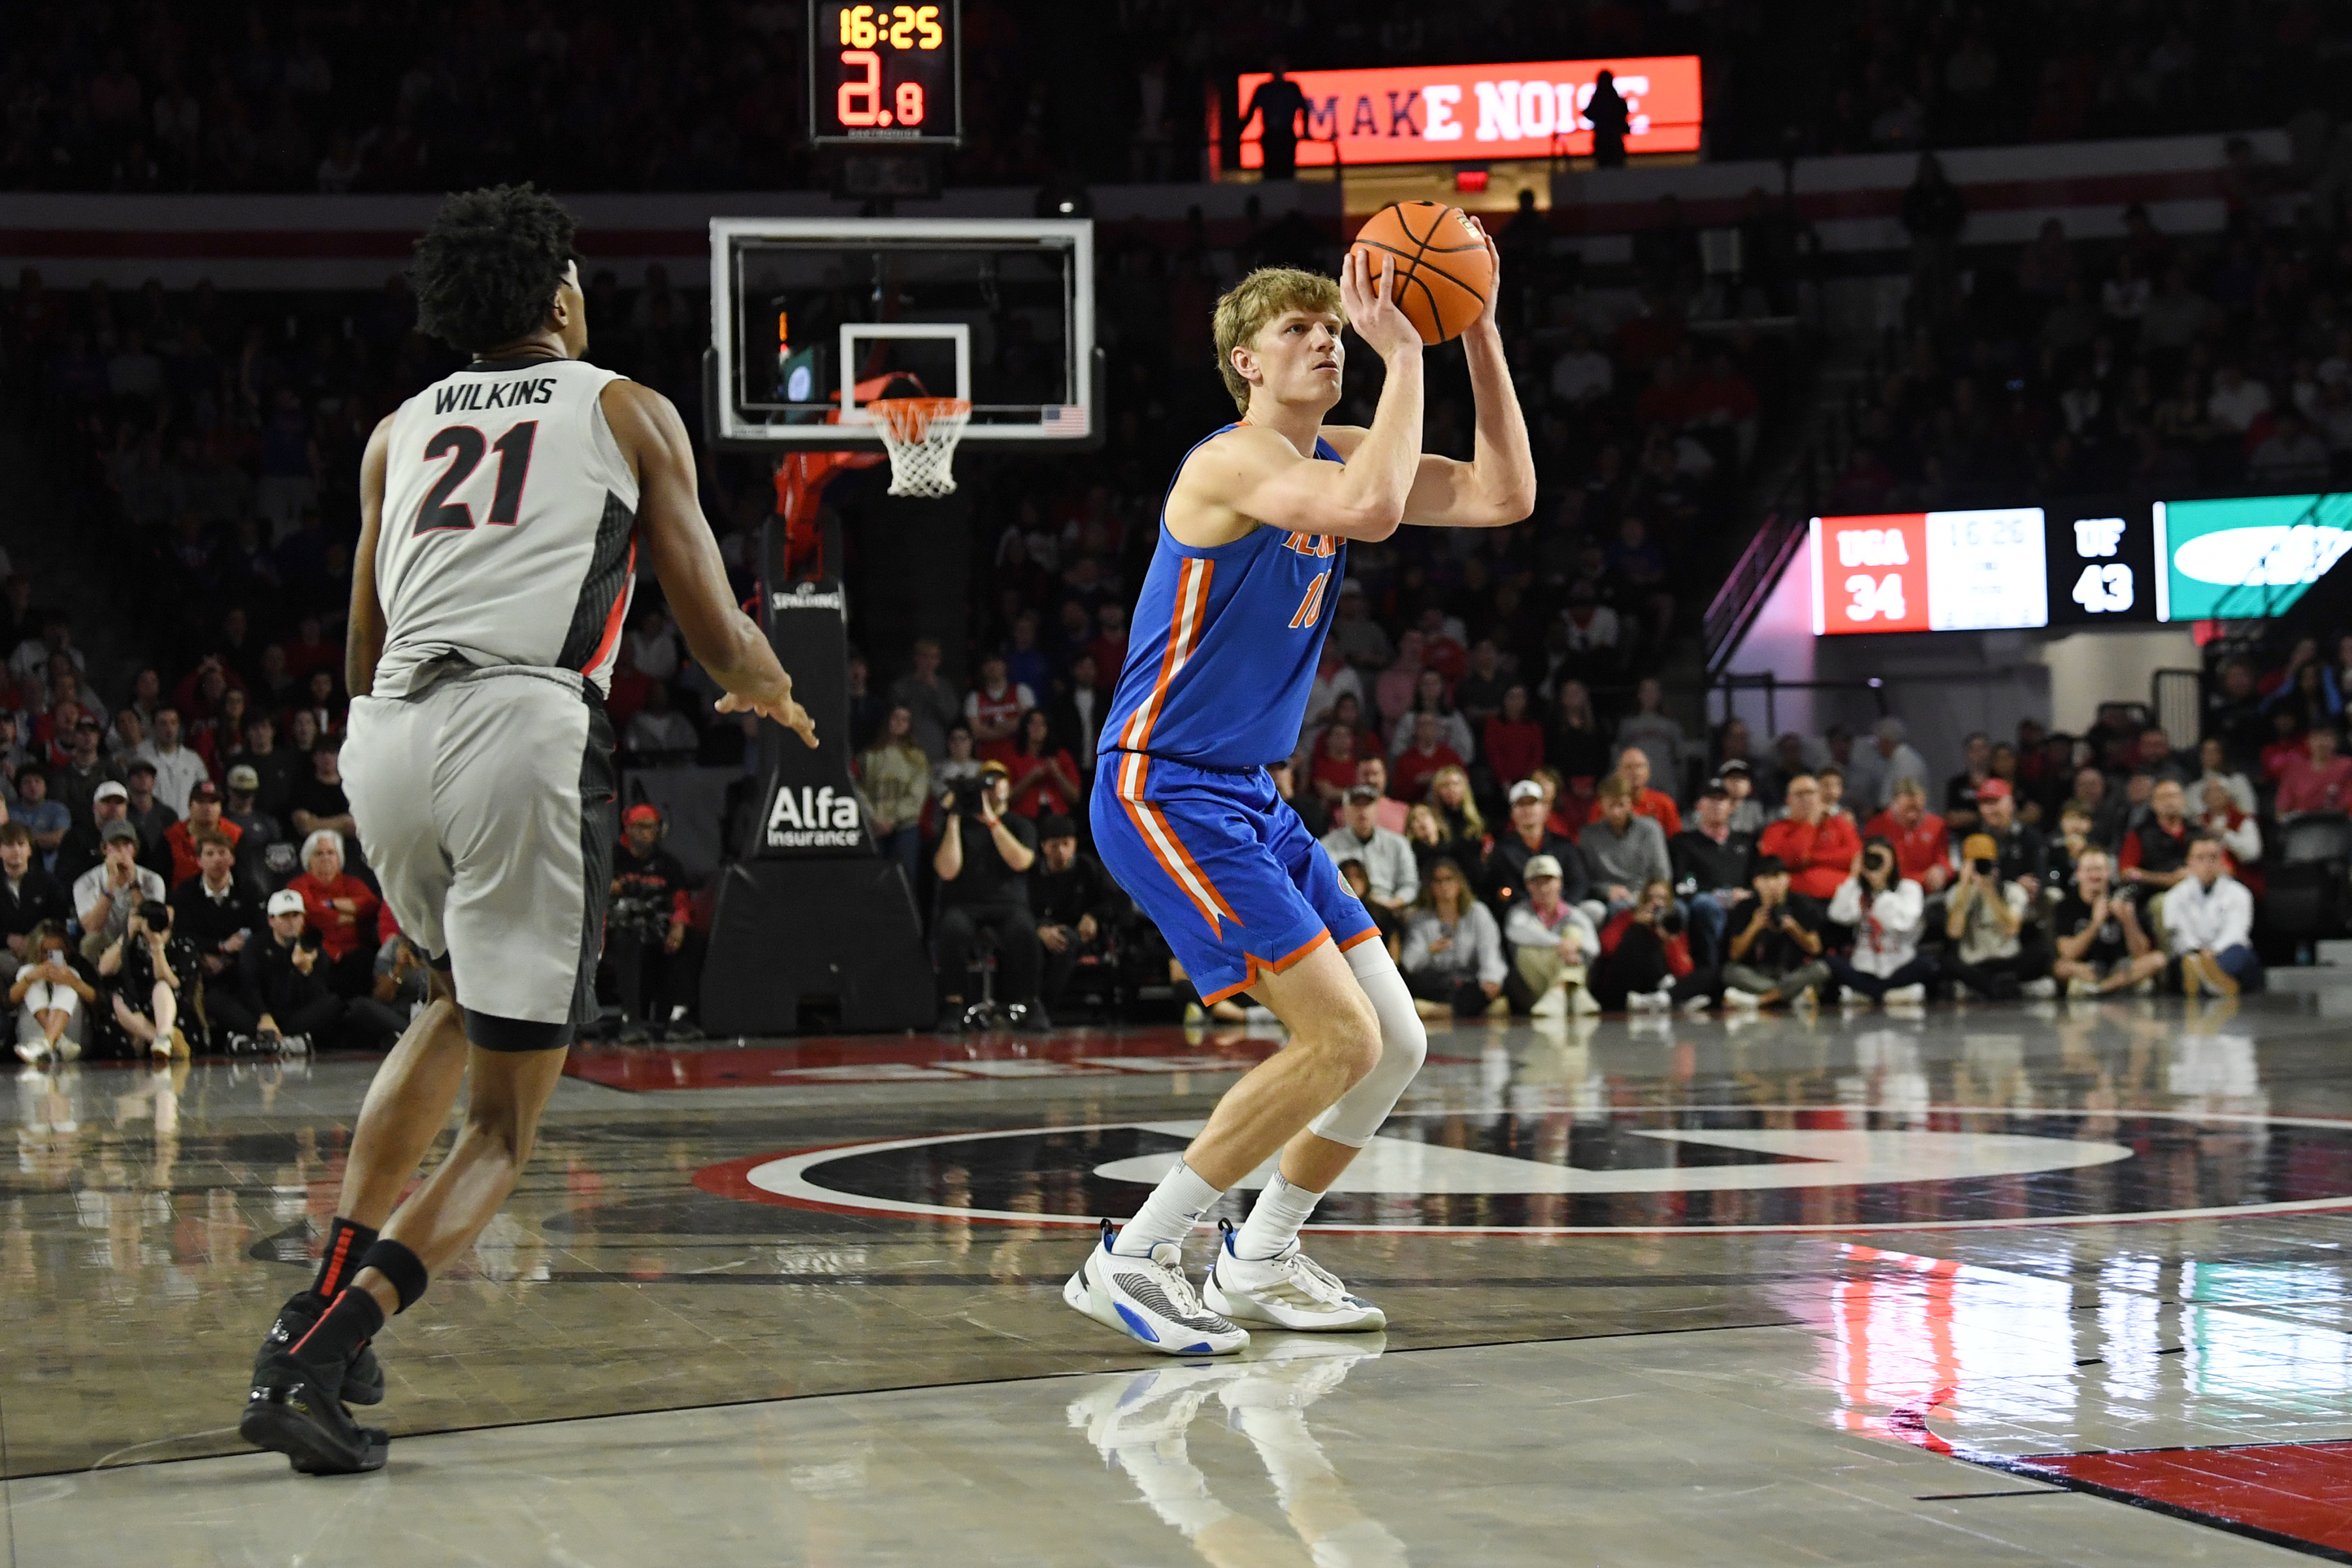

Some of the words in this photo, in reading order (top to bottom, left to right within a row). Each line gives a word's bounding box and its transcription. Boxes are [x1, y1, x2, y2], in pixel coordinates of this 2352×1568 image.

[840, 5, 943, 50] 16:25
[1305, 84, 1463, 141] MAKE
[434, 378, 557, 415] WILKINS
[412, 420, 539, 538] 21
[1837, 528, 1910, 567] UGA
[2074, 517, 2126, 558] UF
[1844, 573, 1906, 621] 34
[2072, 563, 2135, 613] 43
[768, 785, 860, 829] Alfa
